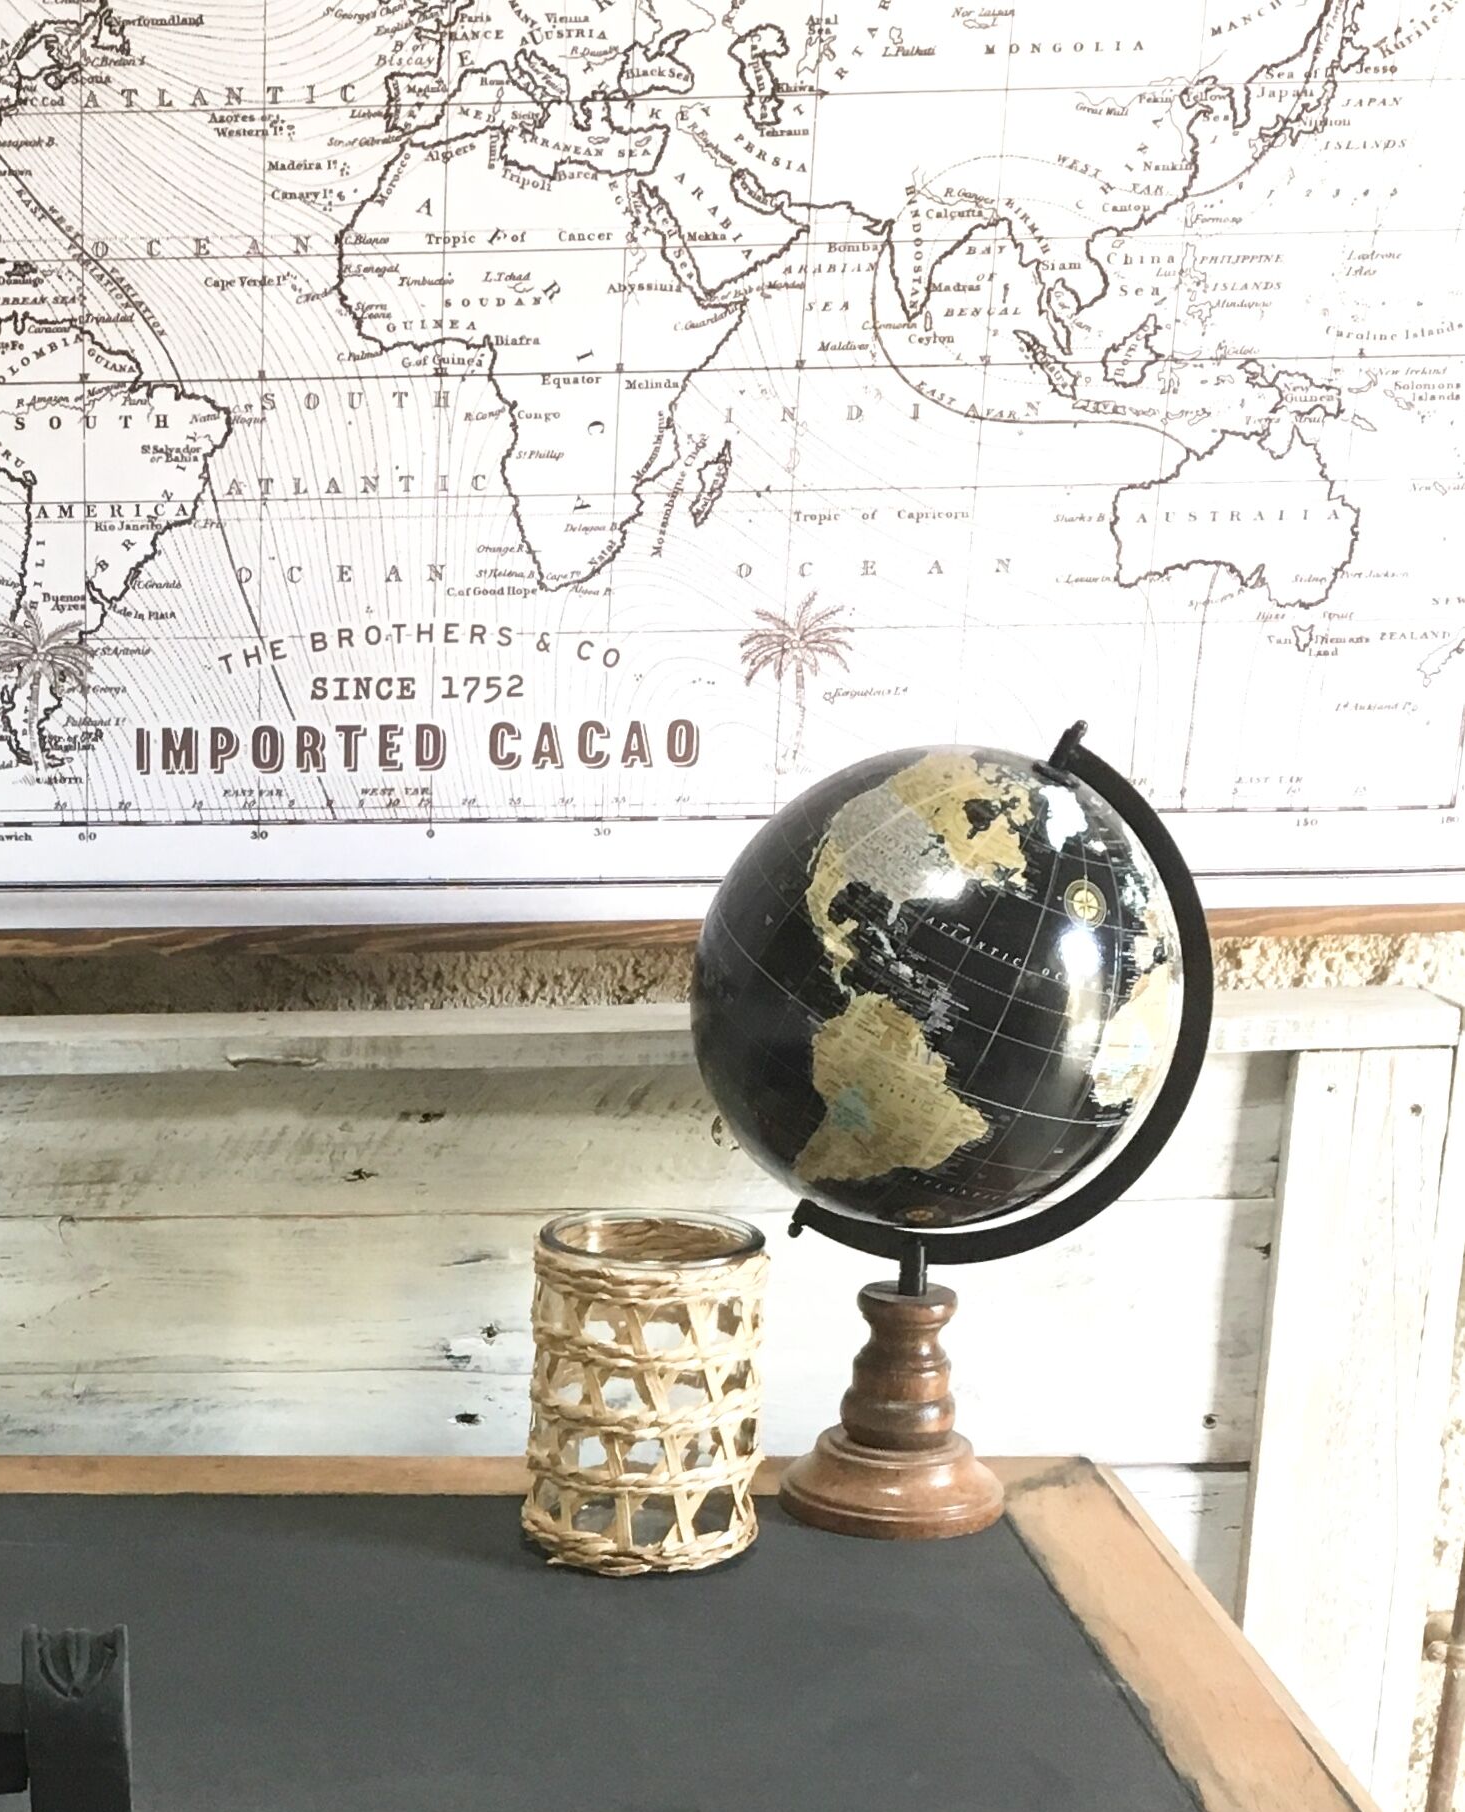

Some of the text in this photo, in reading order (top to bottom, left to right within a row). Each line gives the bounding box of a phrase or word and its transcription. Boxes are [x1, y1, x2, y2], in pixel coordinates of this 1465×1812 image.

[460, 13, 491, 23] Paris
[545, 13, 589, 23] Vienna
[806, 15, 838, 26] Aral
[440, 30, 504, 41] FRANCE
[807, 26, 831, 36] Sea
[520, 29, 607, 46] AUSTRIA
[985, 41, 1144, 54] MONGOLIA
[375, 54, 434, 67] Biscay
[625, 68, 665, 80] Black
[1265, 69, 1294, 80] Sea
[84, 85, 356, 108] ATLANTIC
[1256, 86, 1314, 103] Japan
[1342, 96, 1402, 107] JAPAN
[207, 112, 255, 123] Azores
[214, 126, 269, 137] Western
[1324, 139, 1408, 150] ISLANDS
[425, 143, 476, 164] Algiers
[618, 148, 651, 158] SEA
[734, 133, 807, 173] PERSIA
[268, 160, 323, 171] Madeira
[376, 152, 411, 206] Morocco
[502, 168, 552, 191] Tripoli
[271, 189, 319, 203] Canary
[425, 231, 613, 247] Tropic of Cancer
[688, 231, 726, 242] Mekka
[91, 235, 311, 258] OCEAN
[1107, 253, 1175, 265] China
[1042, 260, 1081, 271] Siam
[204, 276, 273, 289] Cape Verde
[1212, 281, 1283, 292] ISLANDS
[1119, 285, 1159, 297] Sea
[445, 297, 542, 308] SOUDAN
[806, 302, 849, 312] SEA
[386, 320, 477, 333] GUINEA
[495, 335, 541, 346] Biafra
[908, 333, 954, 345] Ceylon
[87, 347, 136, 374] GUIANA
[541, 375, 602, 387] Equator
[625, 379, 679, 390] Melinda
[262, 391, 450, 411] SOUTH
[517, 410, 560, 422] Congo
[15, 414, 170, 431] SOUTH
[226, 474, 487, 496] ATLANTIC
[37, 503, 190, 519] AMERICA
[1136, 508, 1340, 524] AUSTRALIA
[793, 510, 841, 526] Tropic
[862, 509, 878, 520] of
[94, 522, 116, 532] Rio
[737, 558, 1012, 578] OCEAN
[236, 565, 446, 584] OCEAN
[473, 586, 537, 599] Good Hope
[218, 622, 621, 674] THE BROTHERS & CO
[310, 674, 525, 703] SINCE 1752
[135, 719, 701, 775] IMPORTED CACAO
[250, 830, 268, 840] 30
[594, 828, 611, 837] 30
